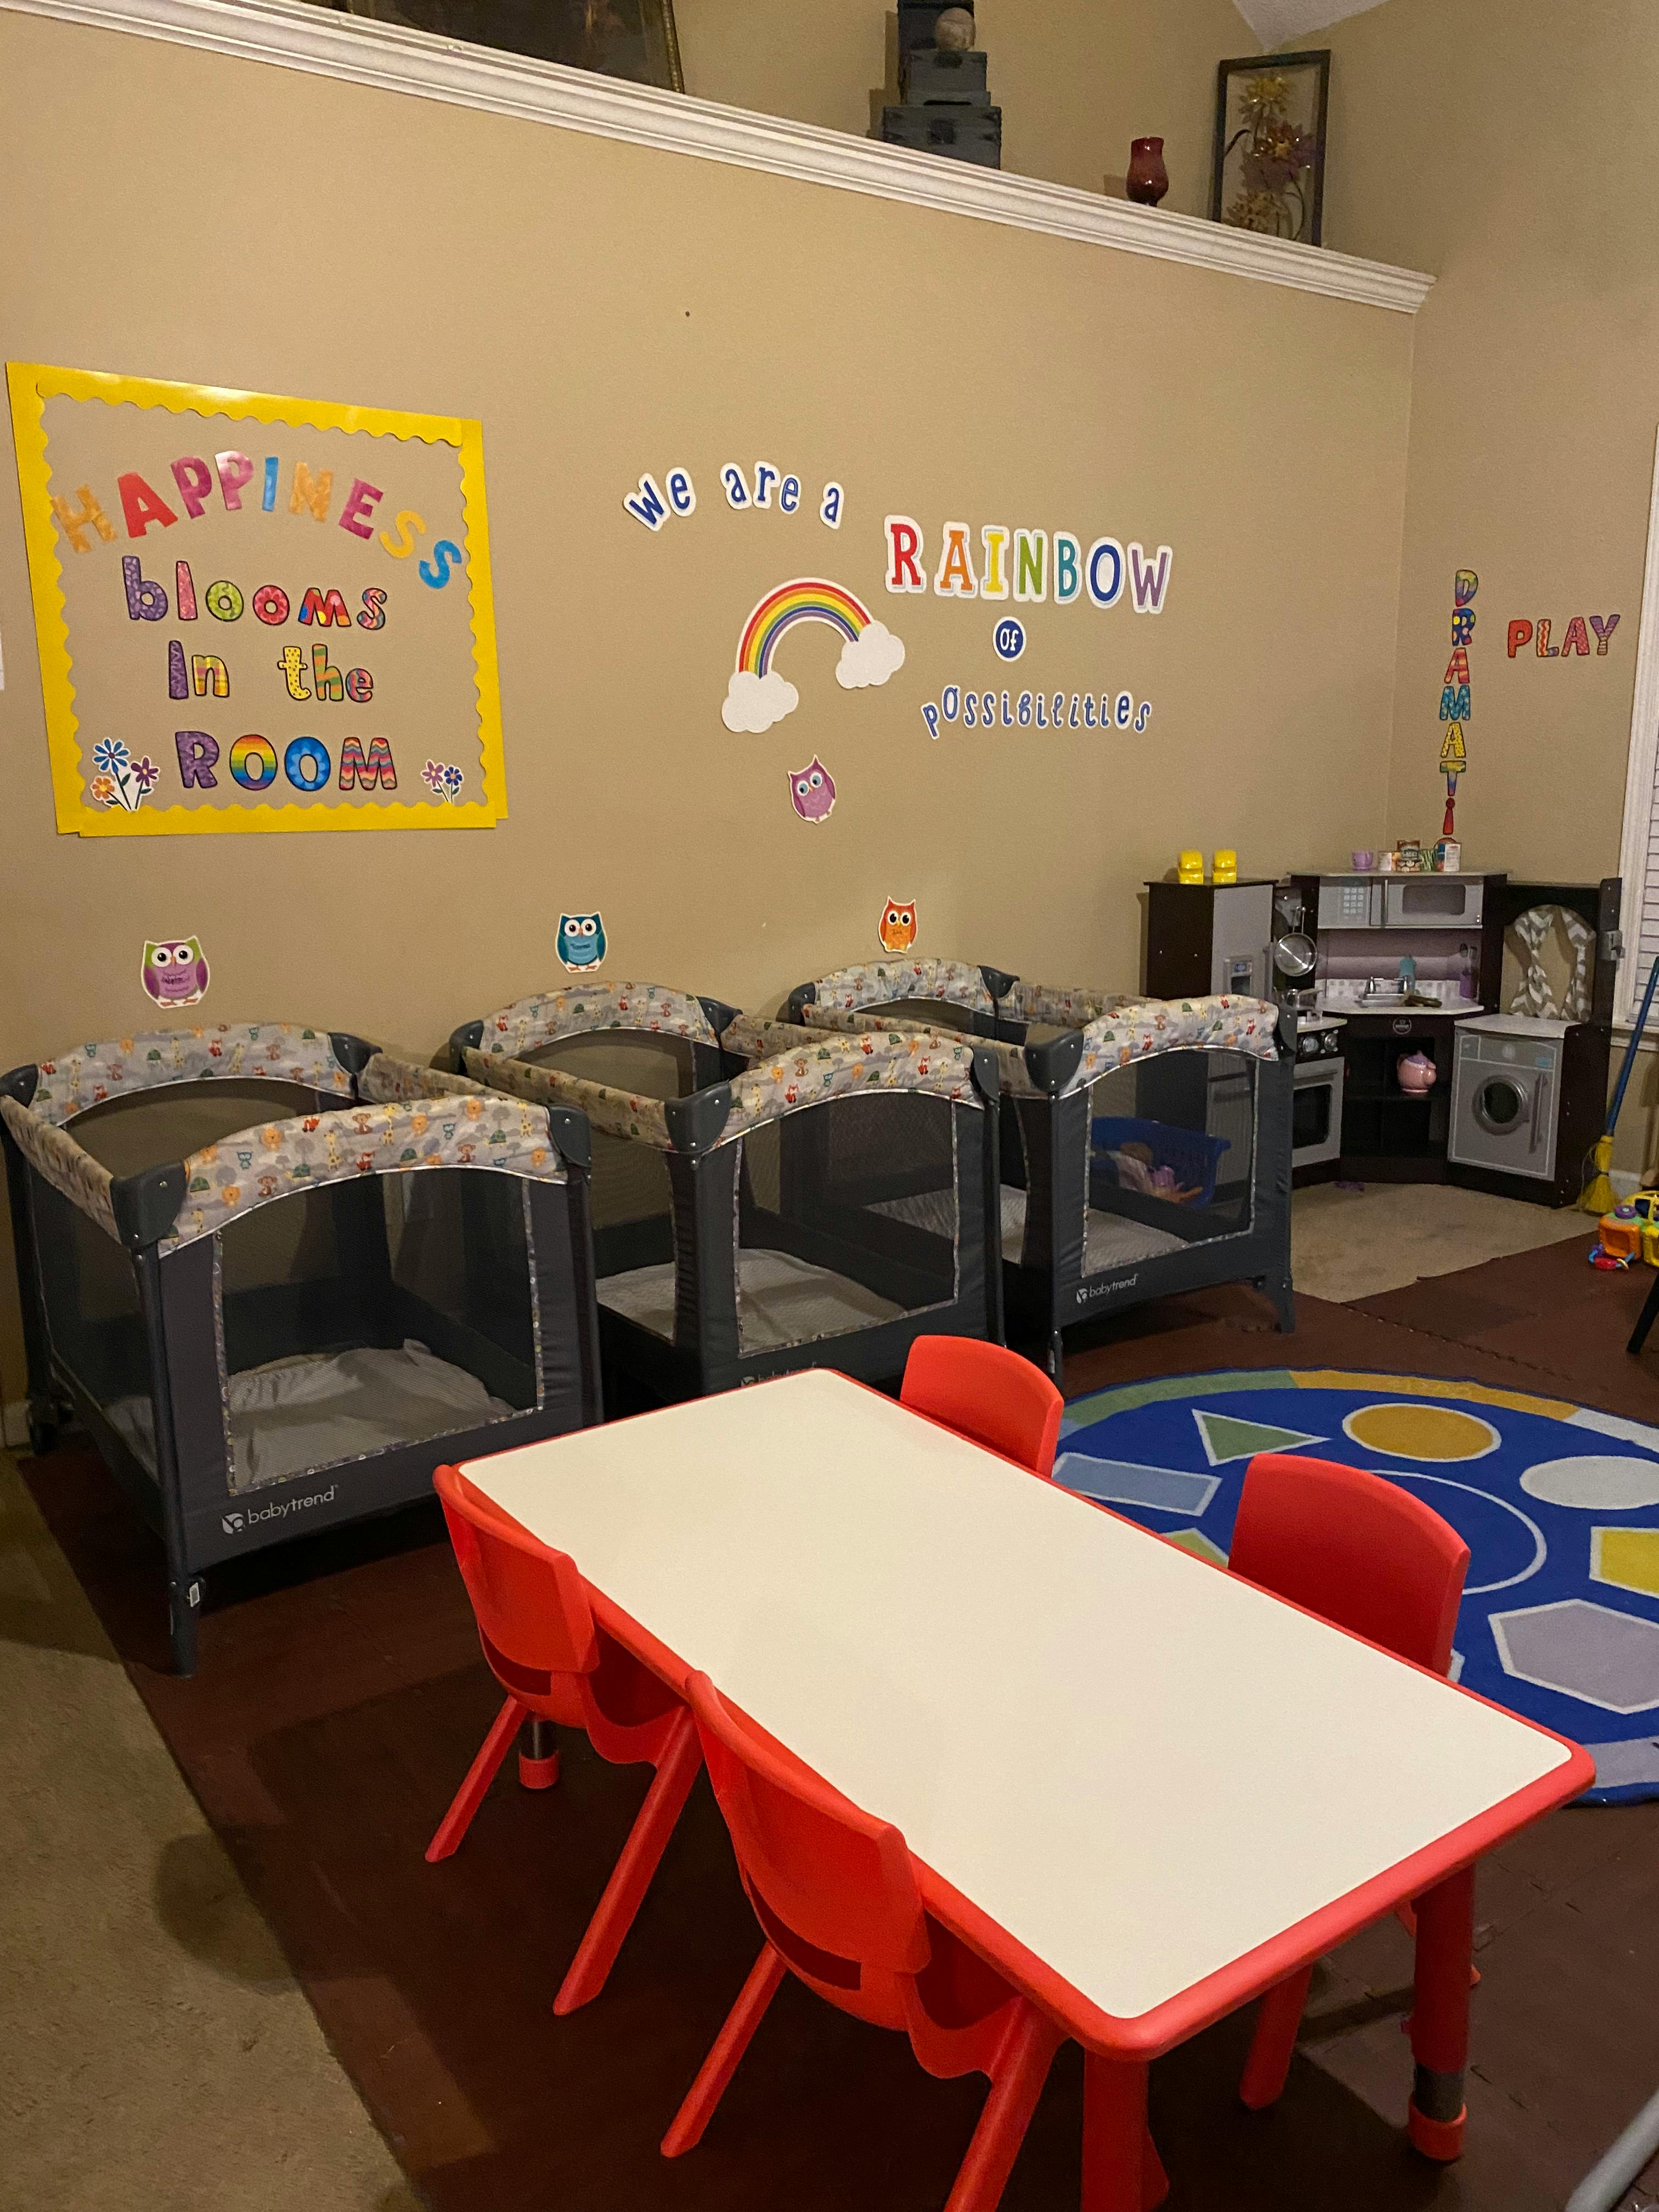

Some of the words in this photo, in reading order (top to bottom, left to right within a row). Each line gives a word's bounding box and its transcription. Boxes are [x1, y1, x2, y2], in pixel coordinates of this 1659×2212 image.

[725, 467, 799, 511] are
[51, 450, 463, 590] HAPPINESS
[890, 523, 1168, 607] RAINBOW
[122, 556, 387, 630] blooms
[1506, 614, 1621, 658] PLAY
[277, 644, 374, 703] the
[922, 687, 1151, 738] possibilities
[174, 731, 398, 792] ROOM
[1089, 1273, 1137, 1297] babytrend
[247, 1485, 335, 1525] babytrend
